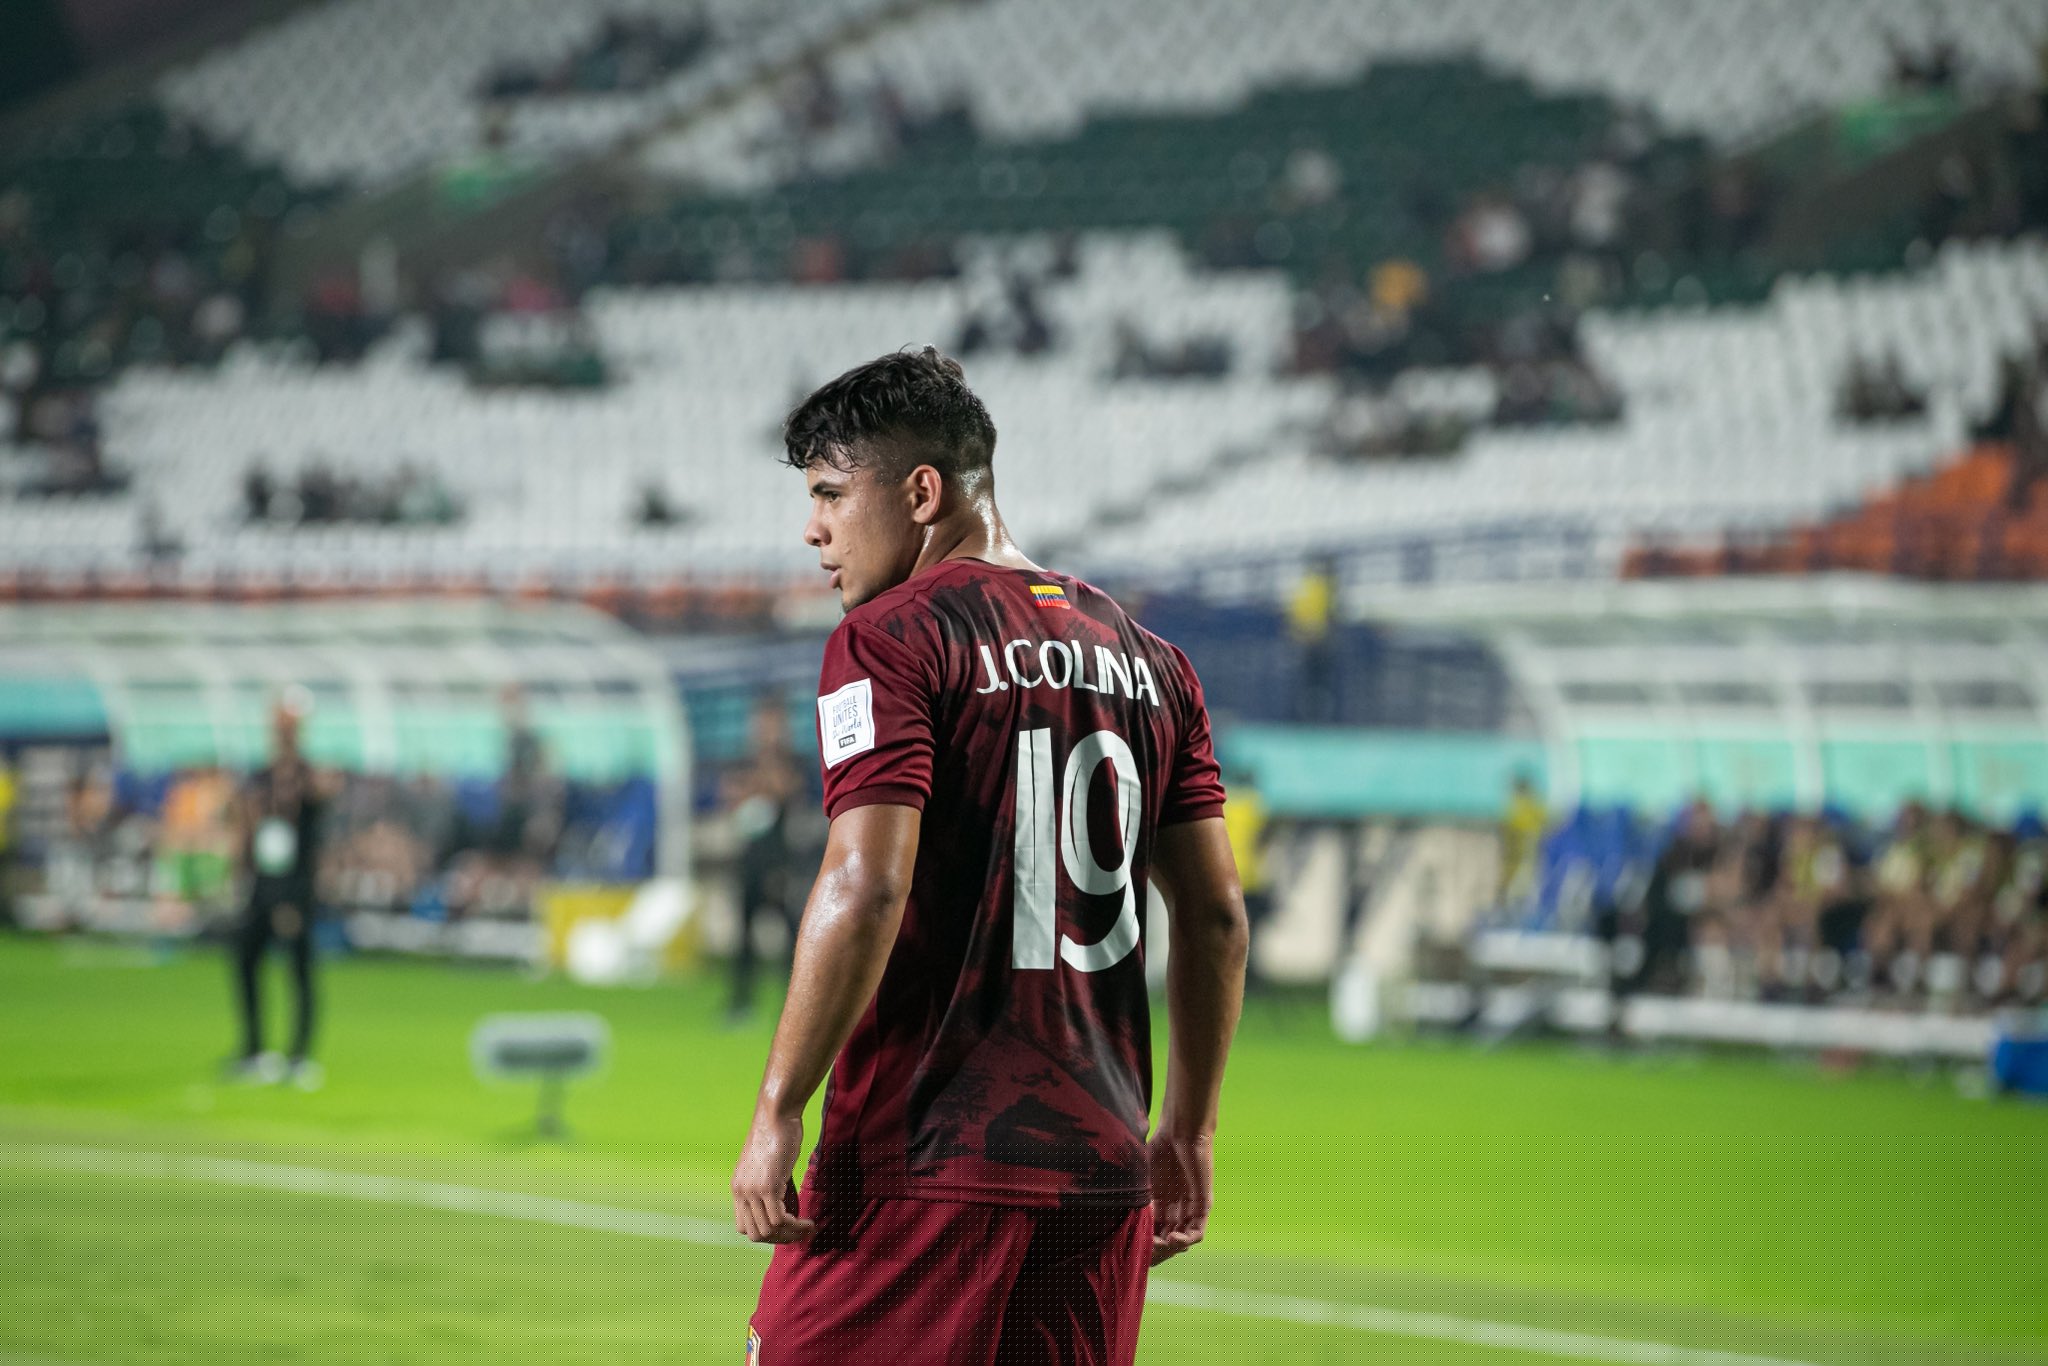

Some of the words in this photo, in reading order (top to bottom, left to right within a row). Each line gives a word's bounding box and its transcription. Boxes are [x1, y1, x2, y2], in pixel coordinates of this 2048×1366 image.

[976, 639, 1159, 706] J.COLINA
[833, 704, 859, 728] UNITES
[839, 736, 855, 747] FIFA
[1012, 727, 1142, 972] 19
